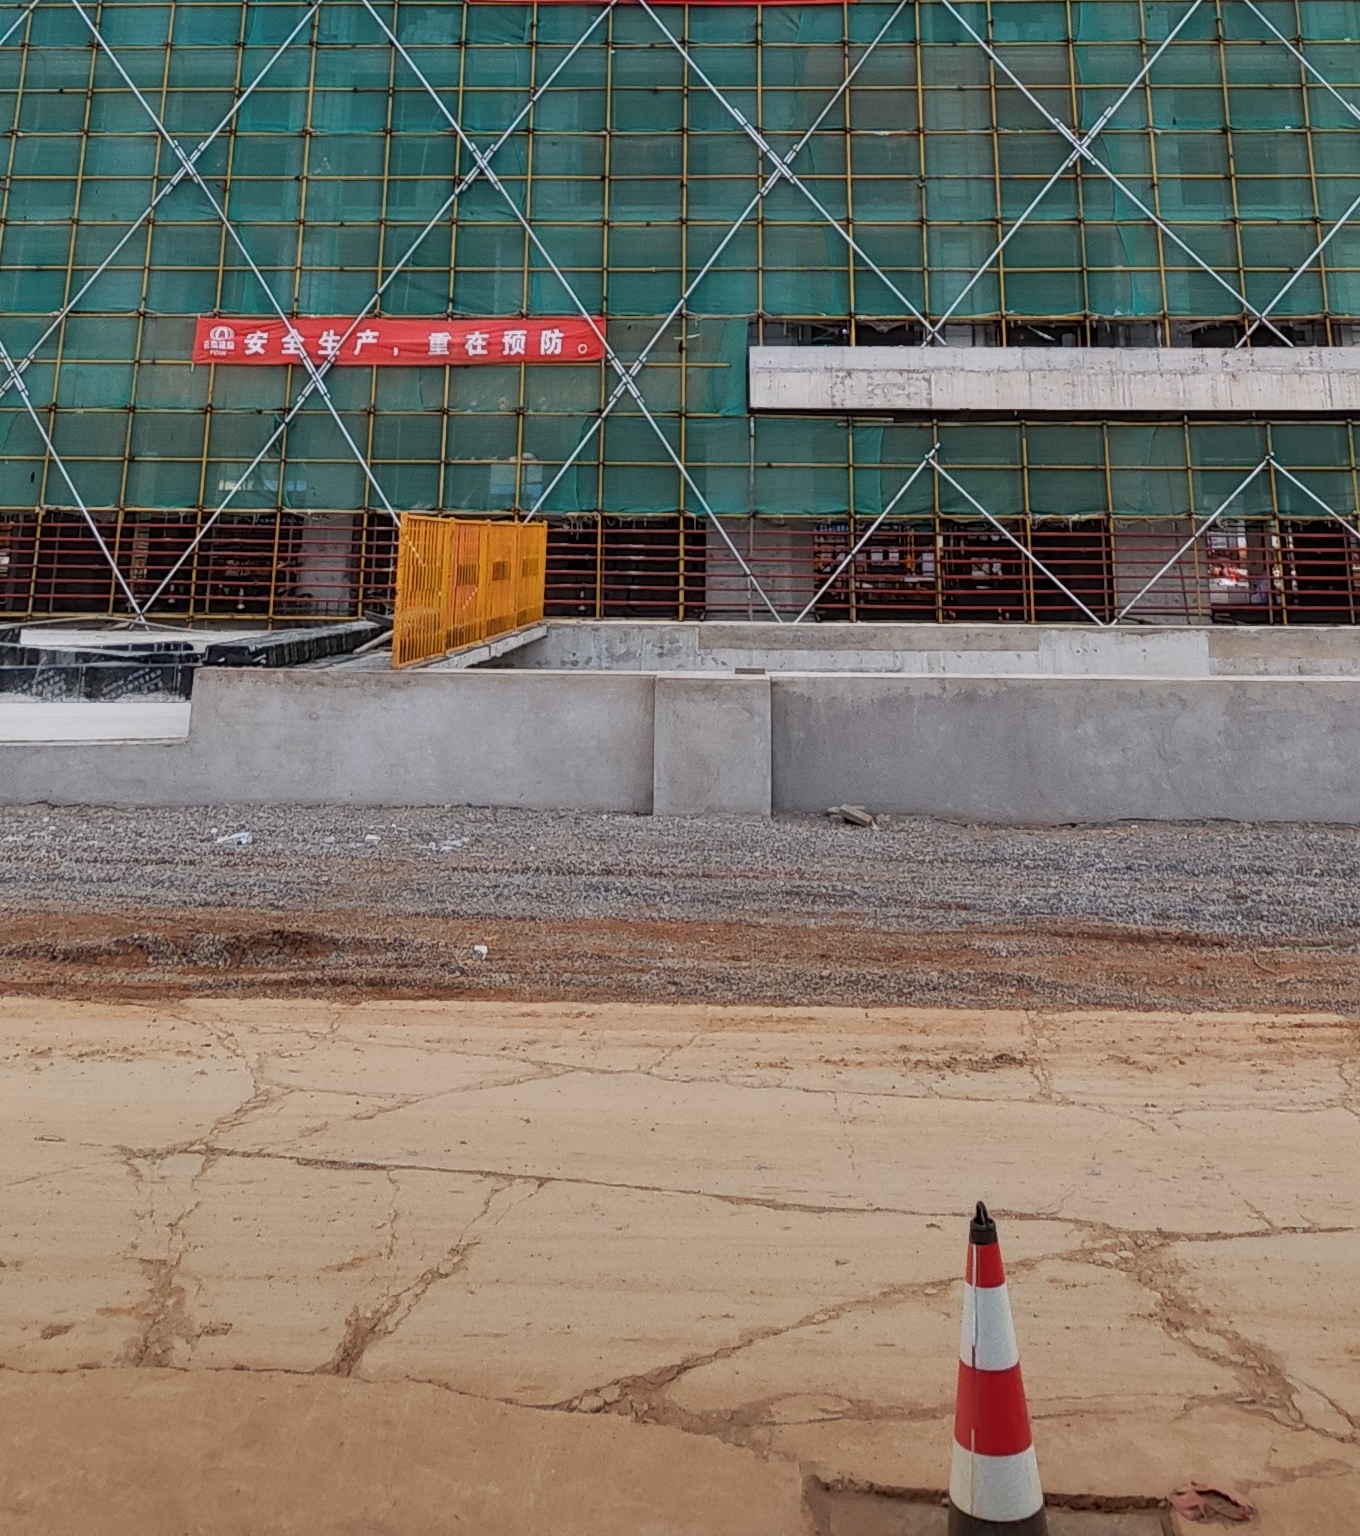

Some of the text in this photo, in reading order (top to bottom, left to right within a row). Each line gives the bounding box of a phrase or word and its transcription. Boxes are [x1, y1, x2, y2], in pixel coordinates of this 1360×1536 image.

[244, 330, 589, 356] 安全生产，重在预防。
